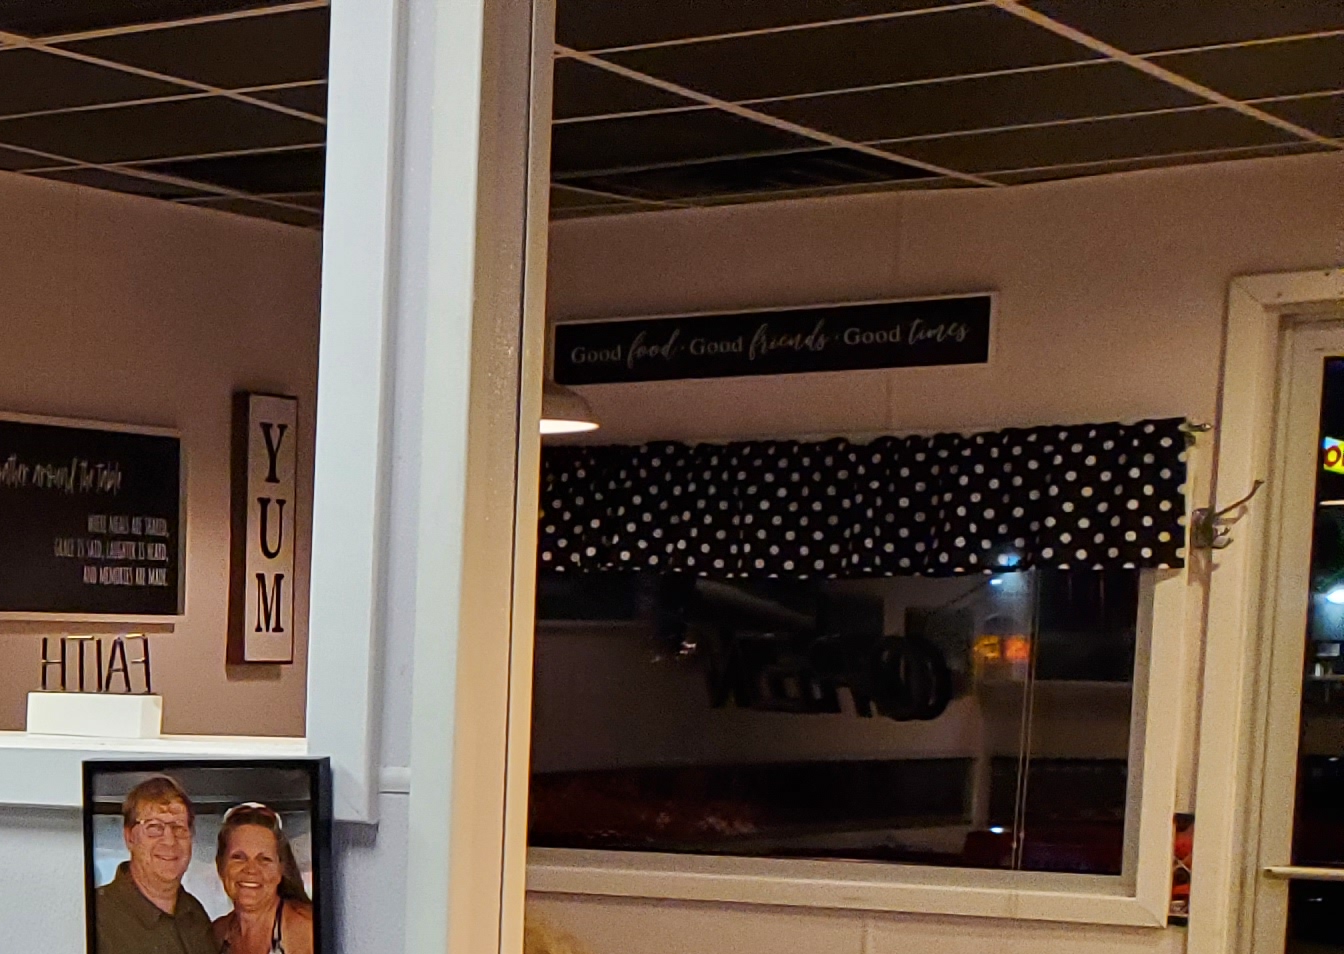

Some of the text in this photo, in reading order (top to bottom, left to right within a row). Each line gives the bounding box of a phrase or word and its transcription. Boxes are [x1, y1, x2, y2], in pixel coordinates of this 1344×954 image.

[570, 317, 972, 371] Good food Good friends Good times
[254, 421, 289, 634] YUM
